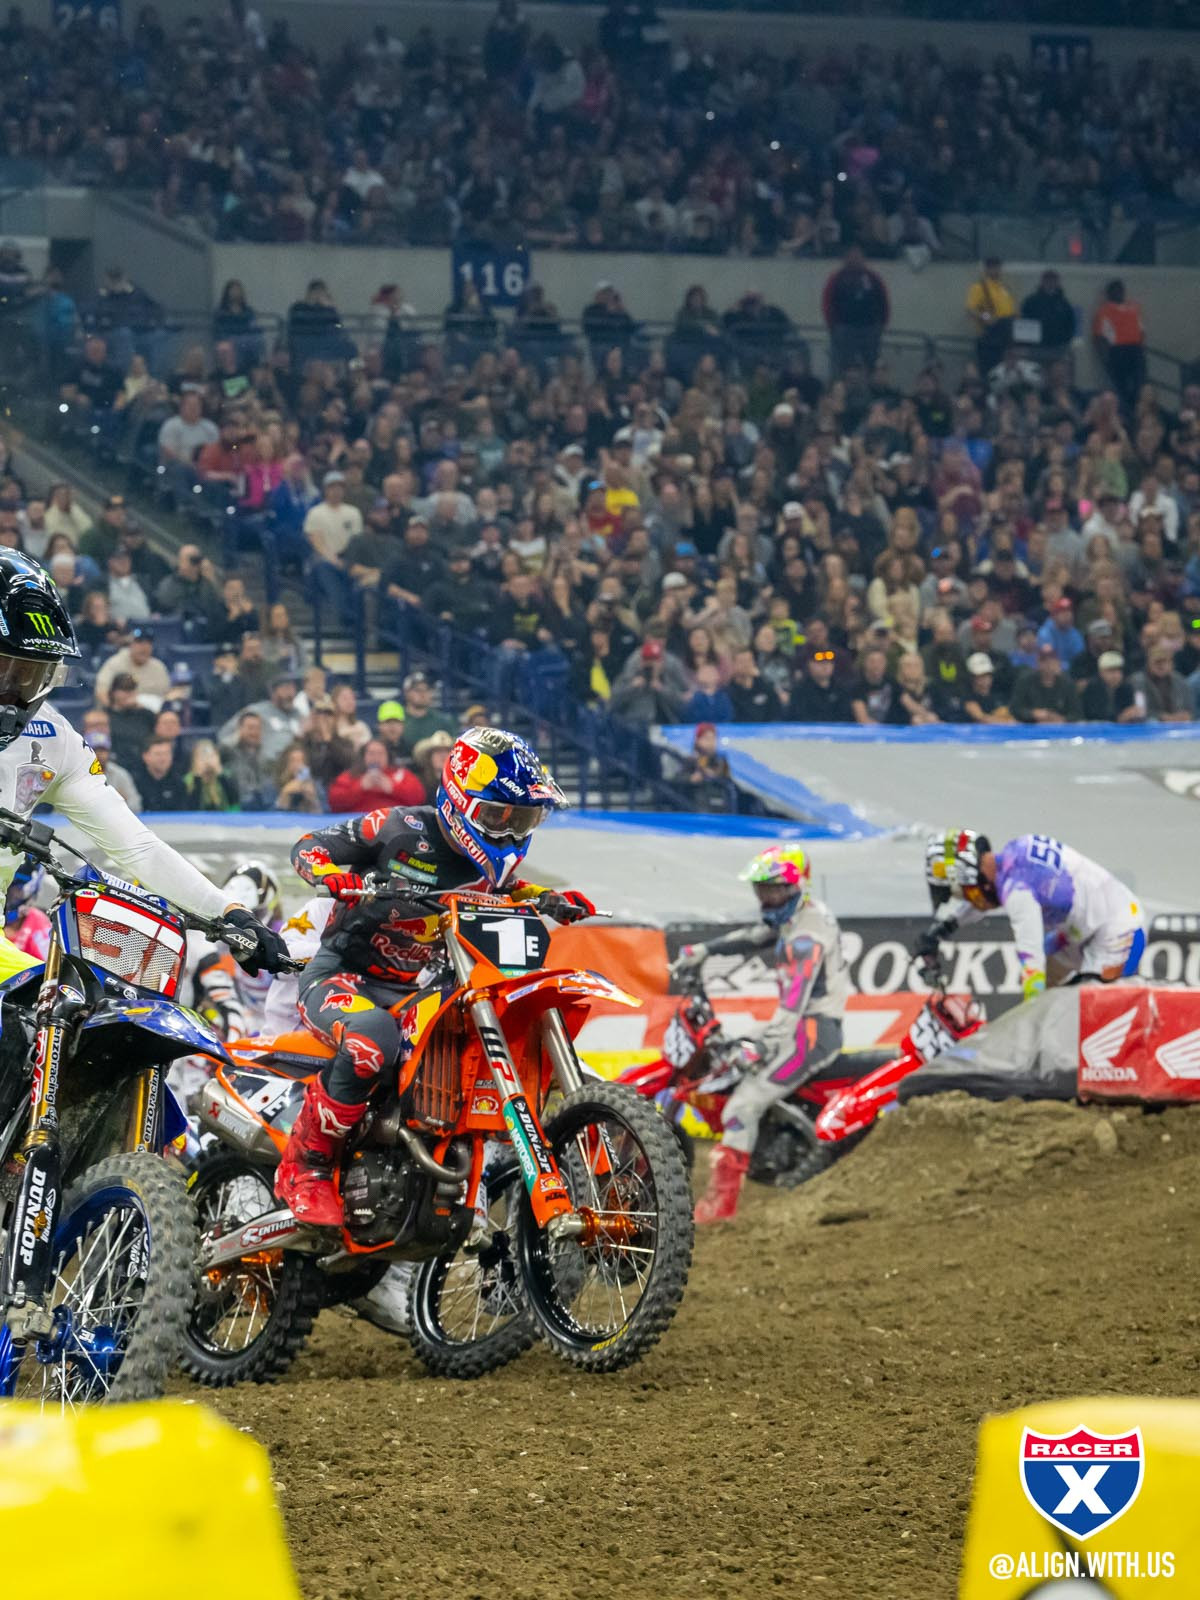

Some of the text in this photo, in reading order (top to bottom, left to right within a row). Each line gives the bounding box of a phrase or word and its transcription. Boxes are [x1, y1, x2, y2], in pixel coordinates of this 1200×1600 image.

[459, 262, 524, 296] 116
[500, 777, 526, 797] AIROH
[482, 918, 527, 966] 1
[1081, 1066, 1139, 1082] HONDA
[511, 1127, 539, 1181] MOTOREX
[19, 1166, 47, 1266] DUNLOP
